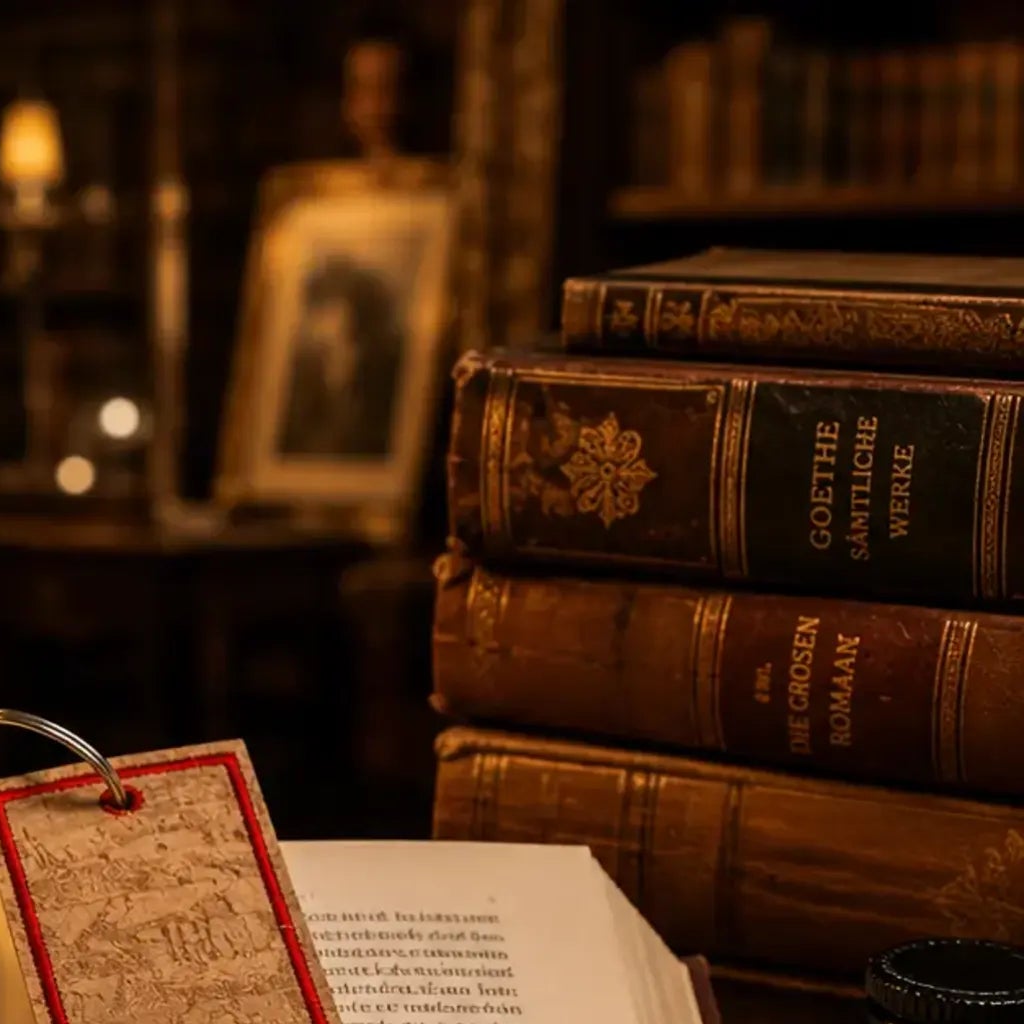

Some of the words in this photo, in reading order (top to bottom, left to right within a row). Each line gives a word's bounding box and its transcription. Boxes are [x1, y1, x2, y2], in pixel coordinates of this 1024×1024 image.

[809, 421, 840, 549] GOETHE
[889, 444, 914, 539] WERKE
[788, 615, 820, 711] GROSEN
[788, 715, 811, 754] DIE
